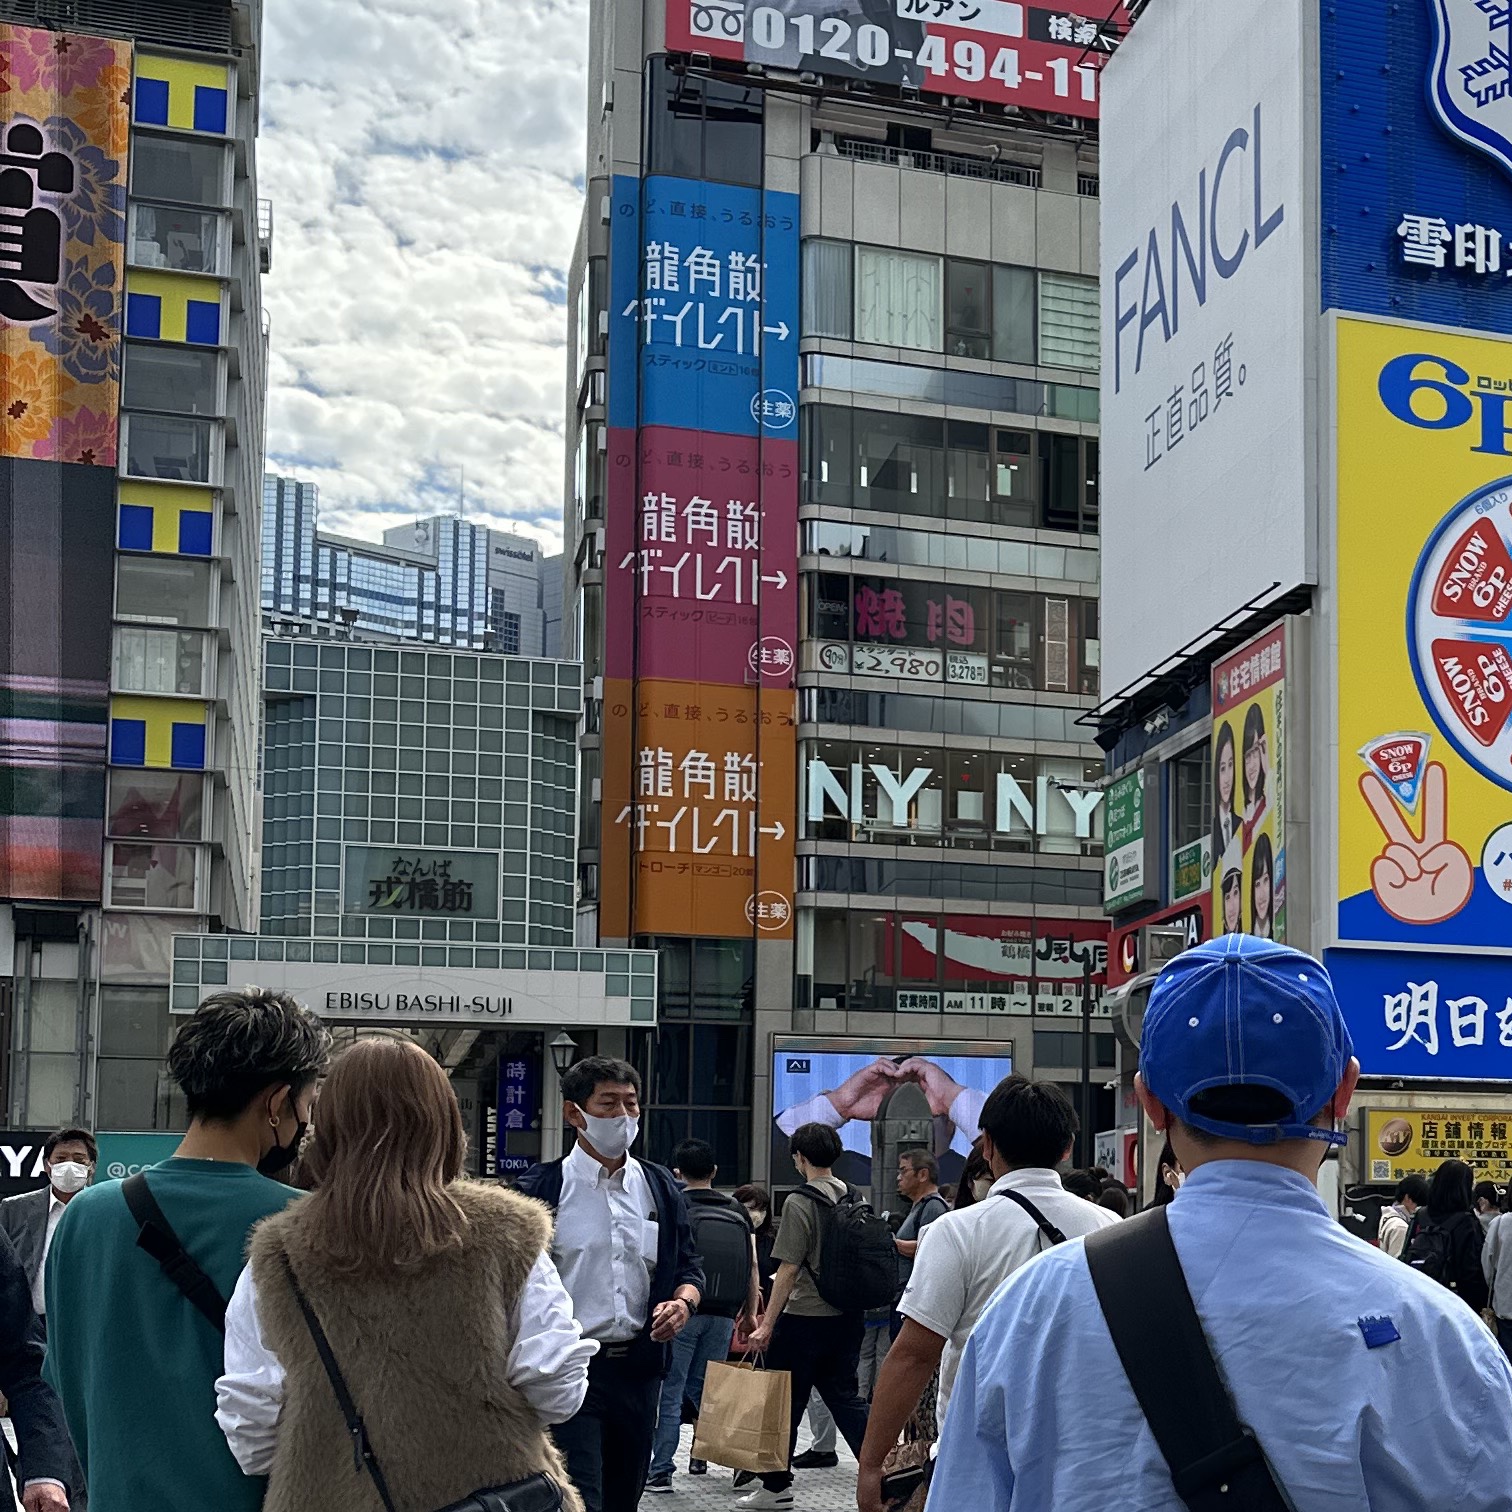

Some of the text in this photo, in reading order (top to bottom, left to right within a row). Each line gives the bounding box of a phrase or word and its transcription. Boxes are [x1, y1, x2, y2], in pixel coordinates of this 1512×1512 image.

[645, 240, 768, 303] 龍角散
[1115, 102, 1284, 395] FANCL
[643, 492, 766, 551] 龍角散
[1442, 531, 1489, 602] SNOW
[854, 584, 976, 646] 焼肉
[1229, 640, 1282, 698] 住宅情報館
[1439, 656, 1490, 727] SNOW
[639, 746, 764, 802] 龍角散
[1379, 744, 1414, 761] SNOW
[808, 760, 1104, 838] NY NY
[392, 857, 452, 877] なんば
[639, 861, 689, 874] トローチ
[326, 992, 389, 1010] EBISU
[898, 994, 938, 1010] 営業時間
[505, 1061, 527, 1129] 時計倉
